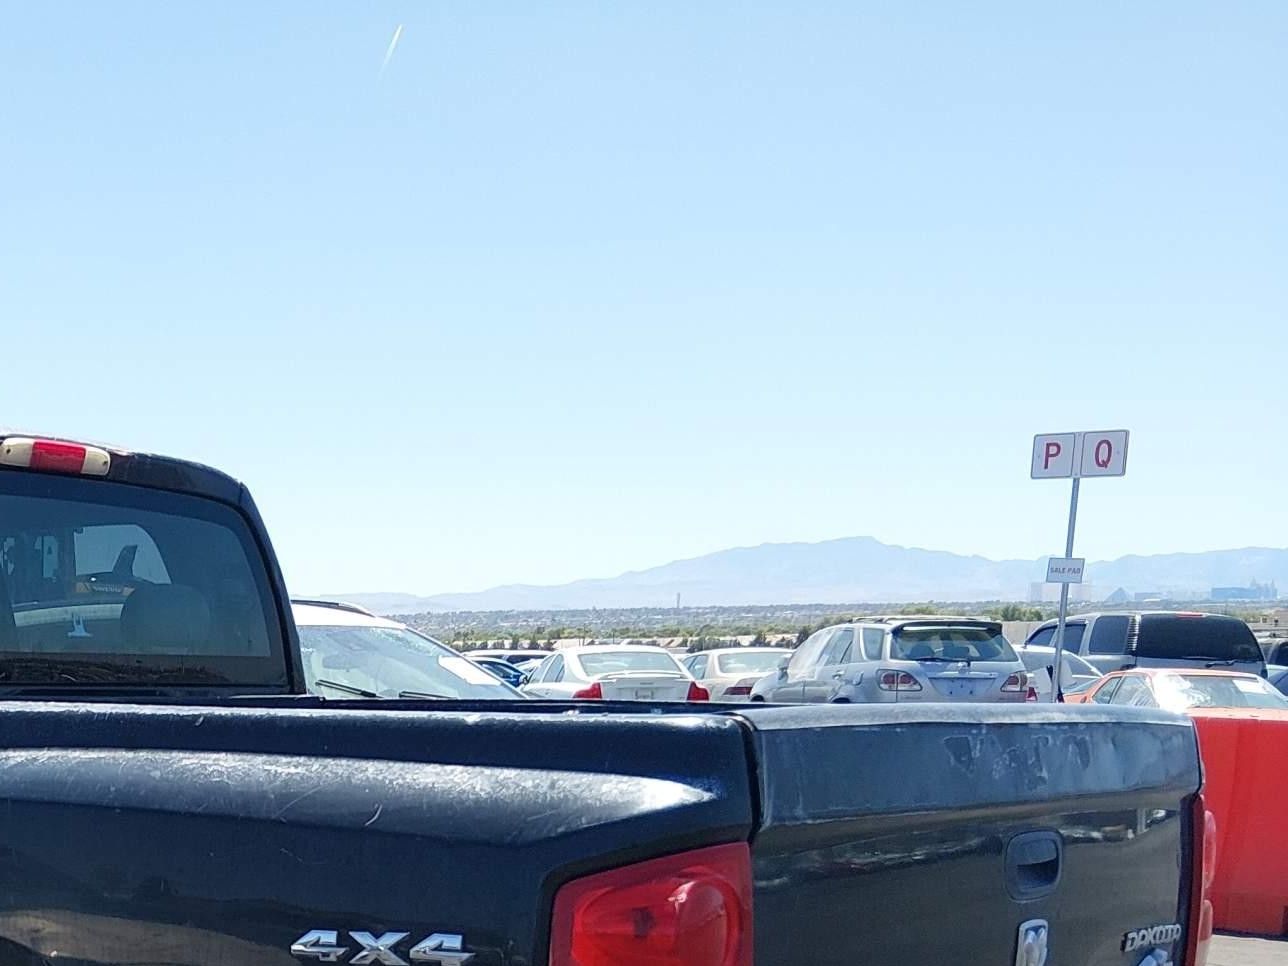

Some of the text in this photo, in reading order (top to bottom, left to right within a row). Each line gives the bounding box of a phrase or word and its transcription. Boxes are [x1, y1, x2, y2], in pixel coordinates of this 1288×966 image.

[1044, 441, 1062, 470] P
[1094, 439, 1113, 469] Q
[1123, 923, 1182, 953] DAKOTA
